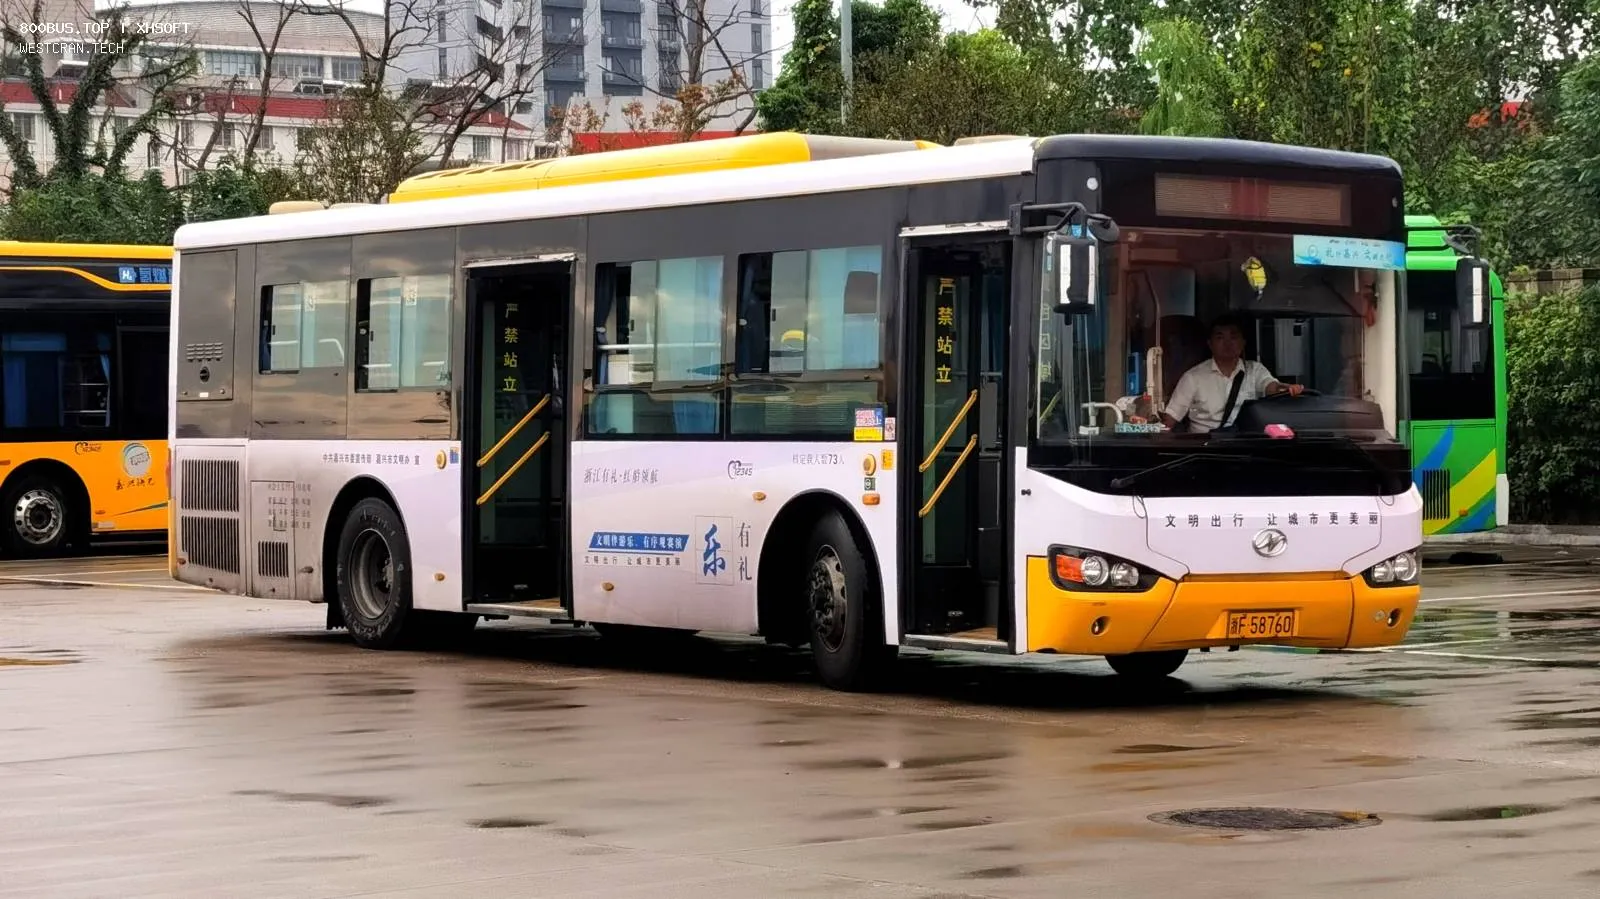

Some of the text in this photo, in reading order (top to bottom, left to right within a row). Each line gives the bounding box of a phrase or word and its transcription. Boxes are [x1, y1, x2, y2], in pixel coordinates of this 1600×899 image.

[503, 303, 518, 392] 严禁站立
[936, 278, 956, 383] 严禁站立
[375, 454, 410, 465] 嘉兴市文明办
[792, 453, 845, 465] 核定载人数73人
[1165, 511, 1379, 528] 文明出行 让城市更美丽
[584, 555, 681, 566] 文明出行 让城市更美丽
[702, 523, 727, 577] 乐
[736, 521, 753, 582] 有礼
